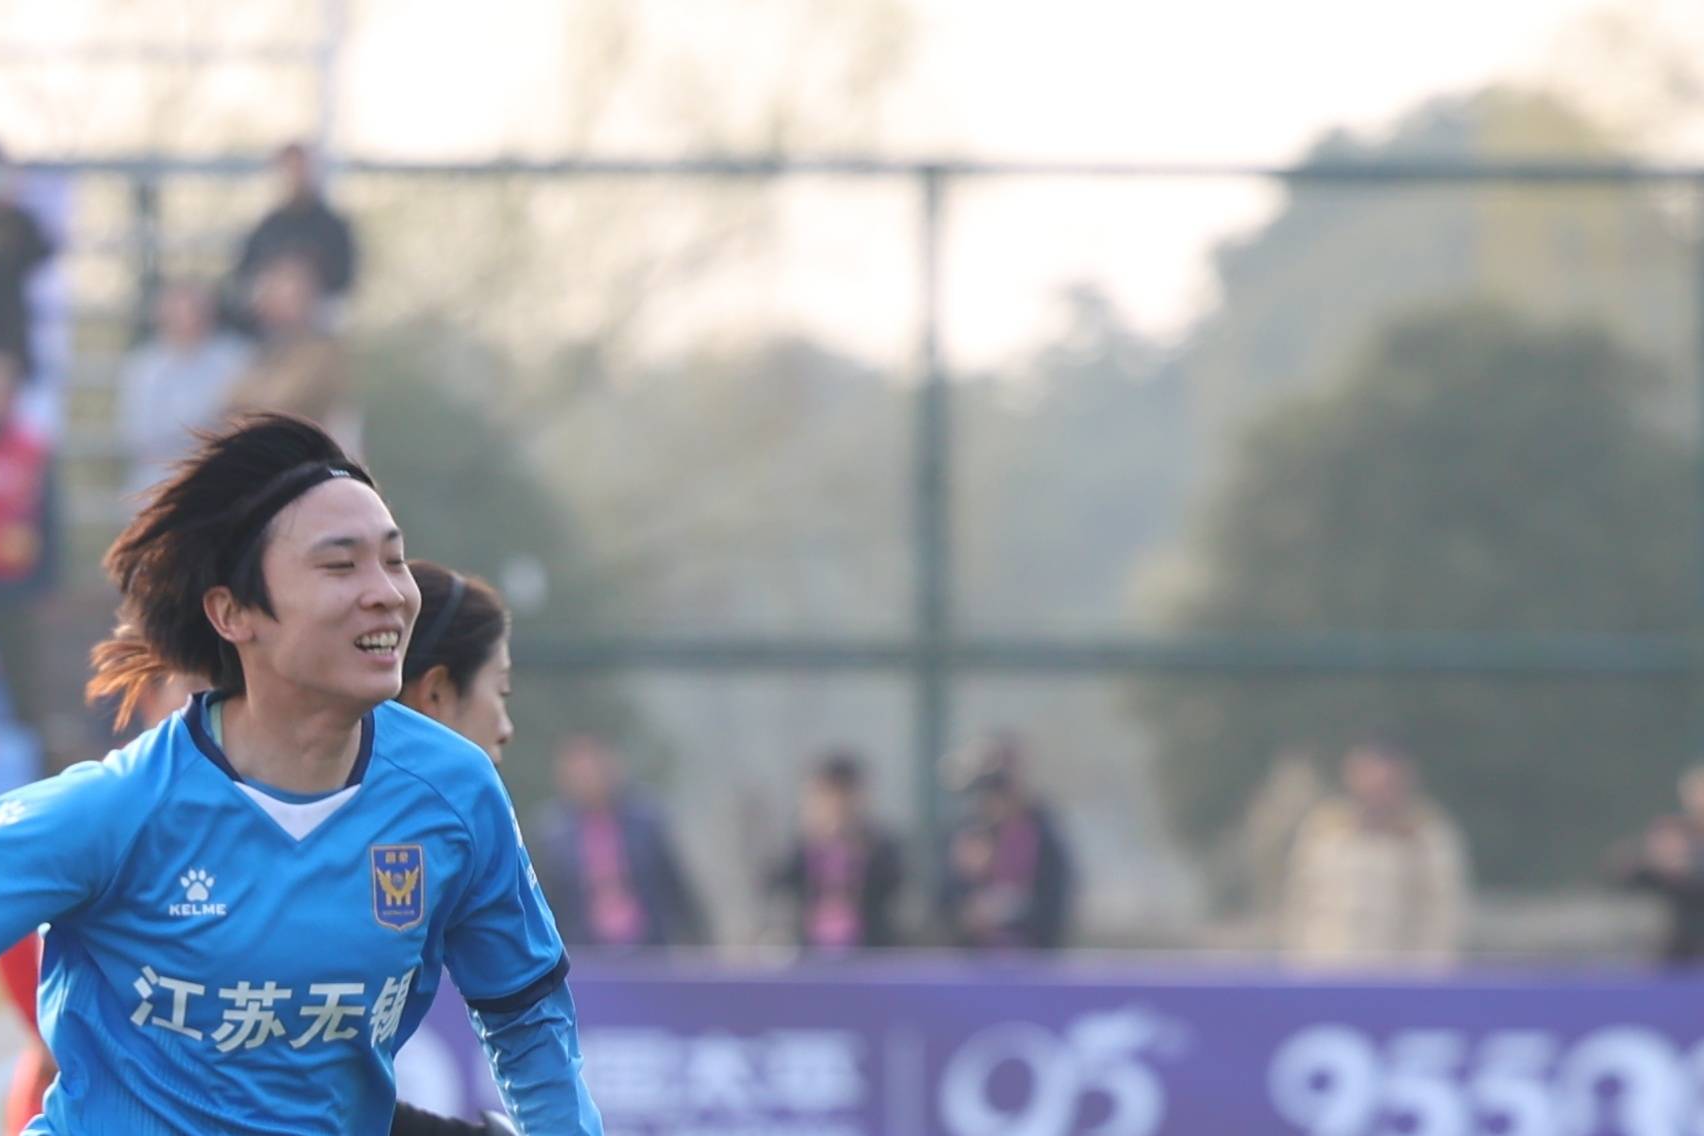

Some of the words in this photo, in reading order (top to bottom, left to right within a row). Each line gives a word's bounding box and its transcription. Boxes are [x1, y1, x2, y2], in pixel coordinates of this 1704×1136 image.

[168, 903, 227, 917] KELME
[129, 965, 416, 1053] 江苏无锡
